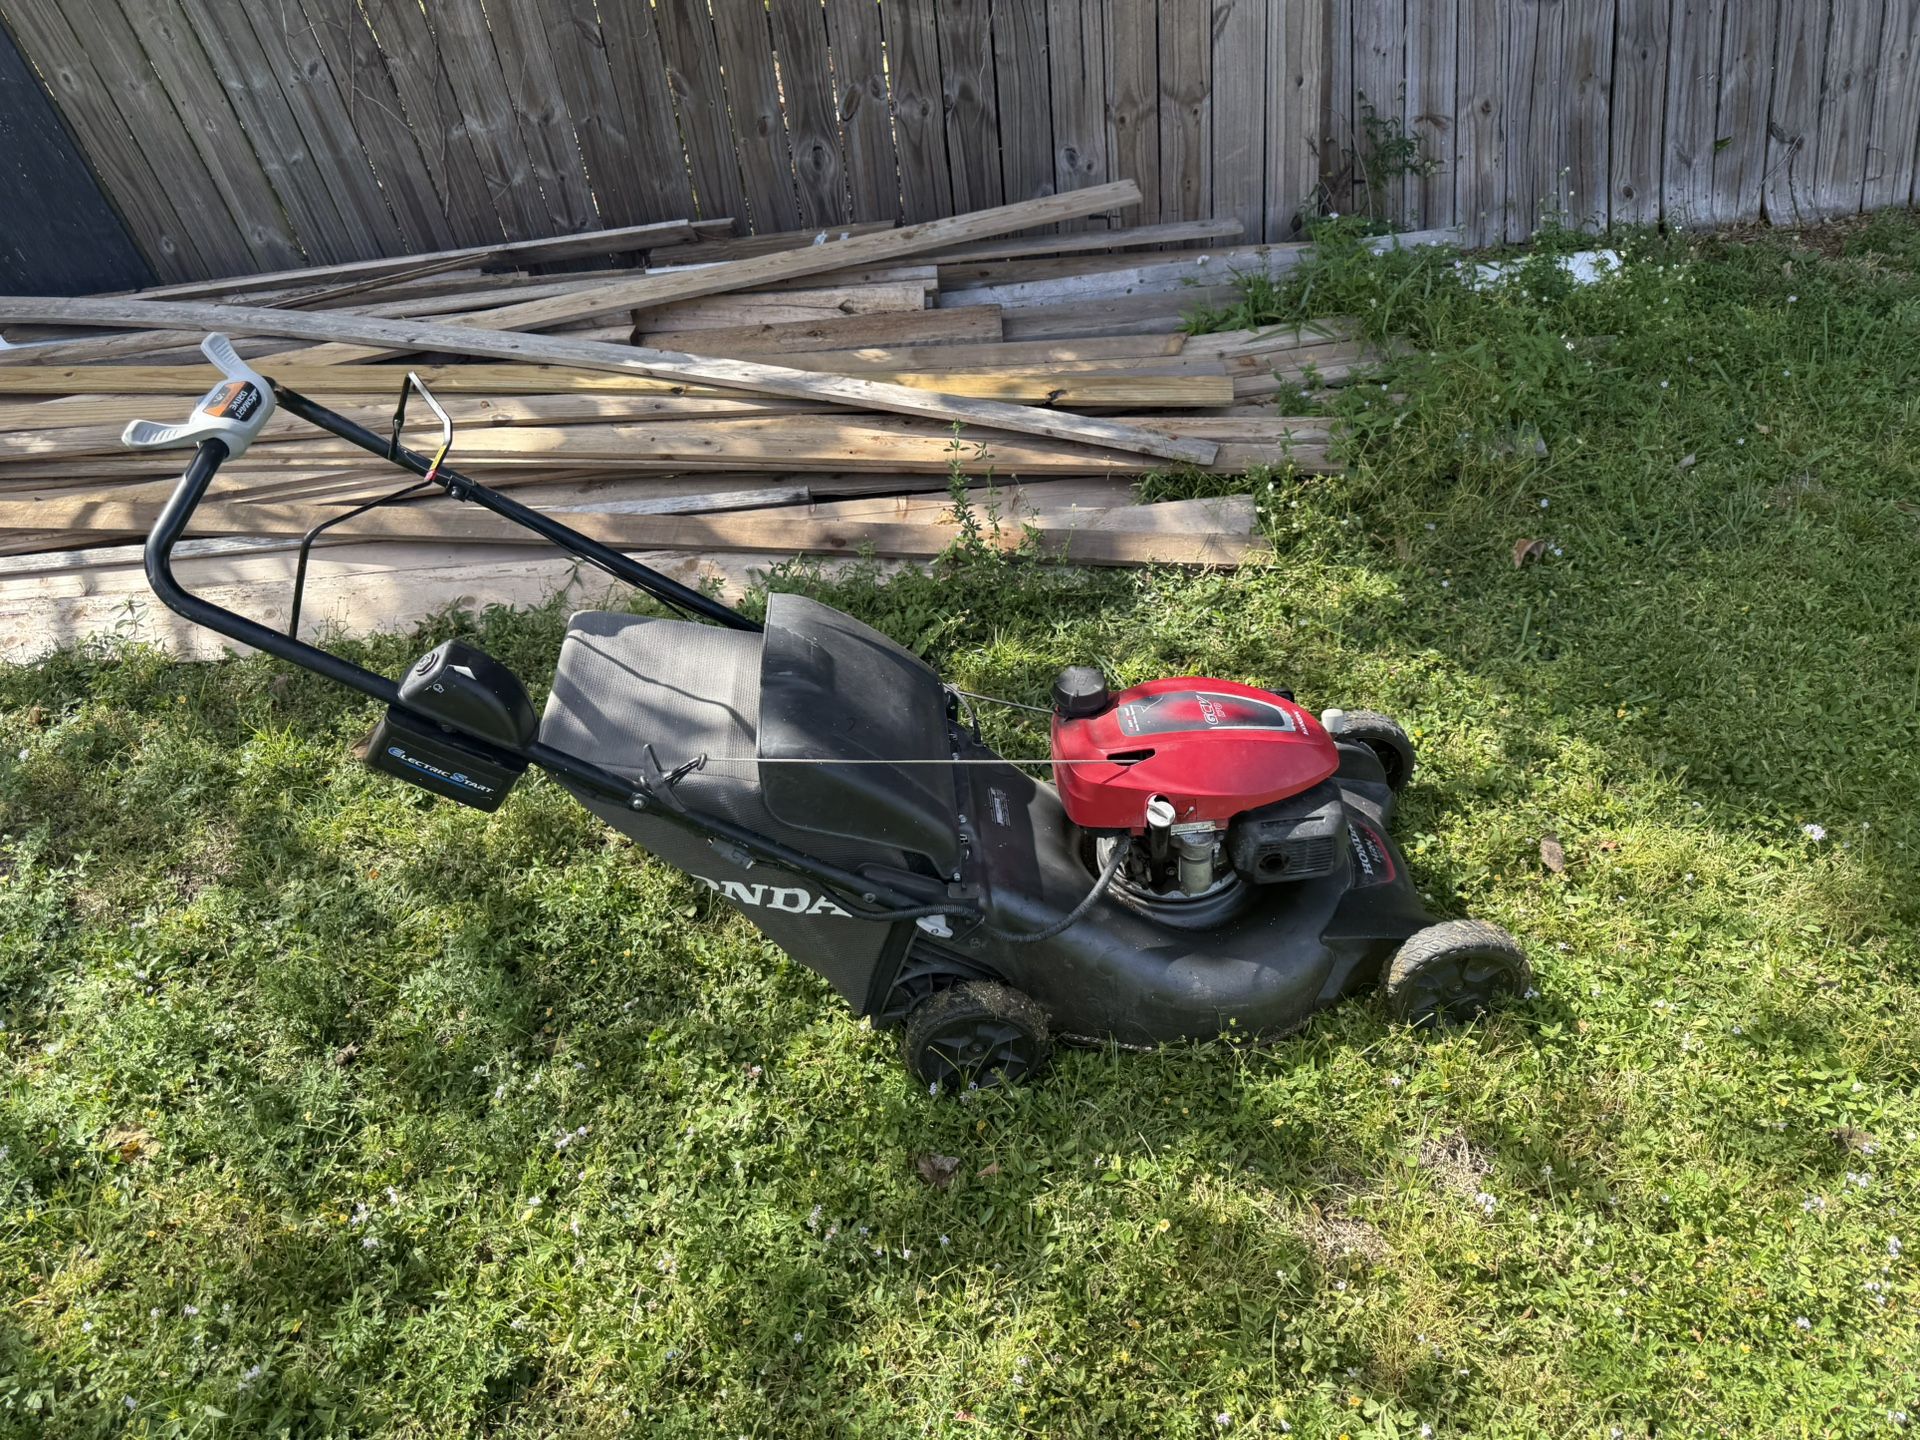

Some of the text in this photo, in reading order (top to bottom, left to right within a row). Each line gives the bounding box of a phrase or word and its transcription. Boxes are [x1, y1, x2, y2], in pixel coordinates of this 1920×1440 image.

[229, 390, 248, 411] DRIVE
[235, 391, 255, 419] SMART
[1195, 694, 1219, 725] GCV
[387, 746, 494, 793] ELECTRIC START
